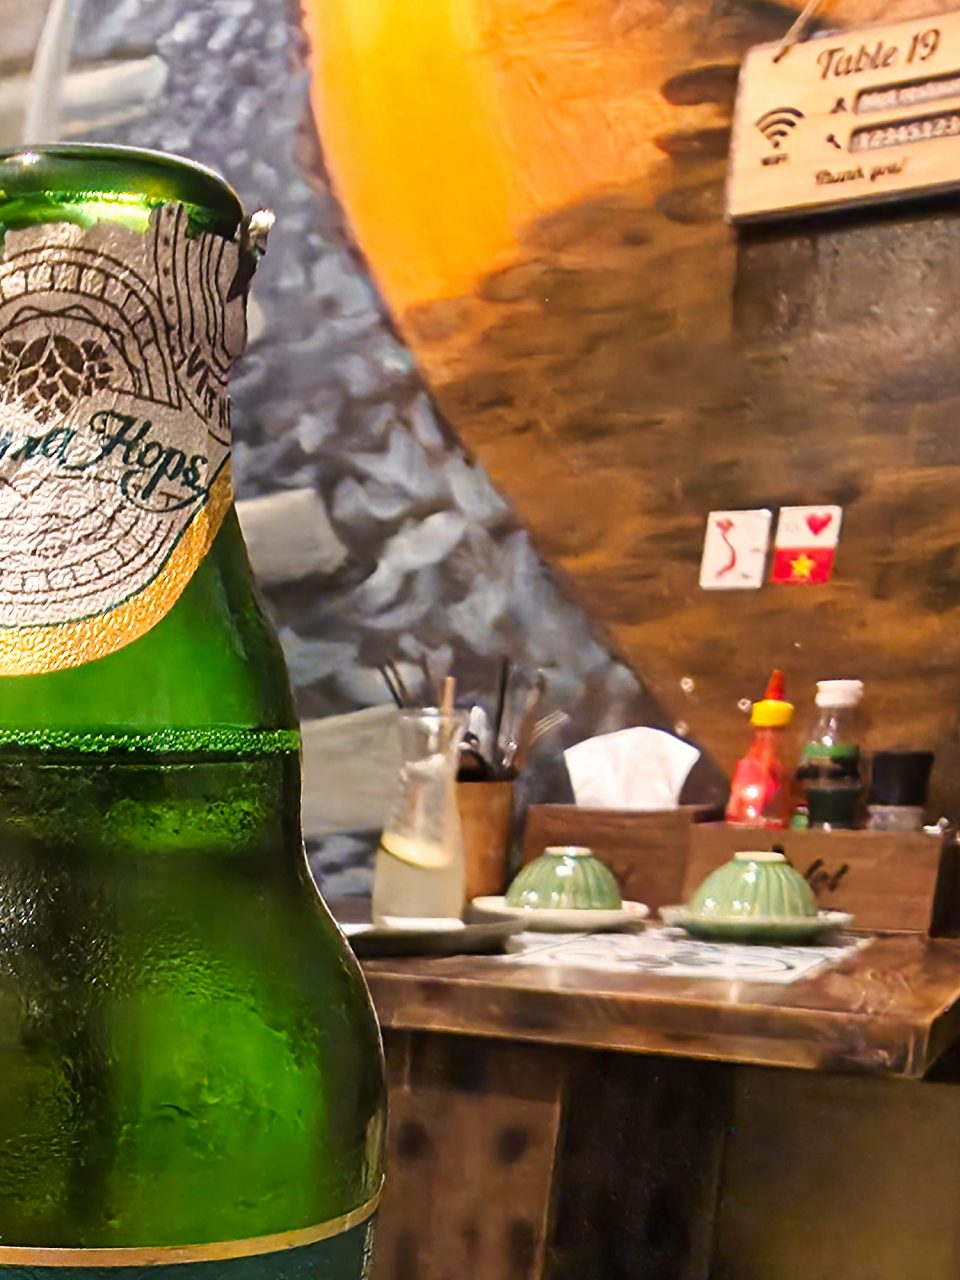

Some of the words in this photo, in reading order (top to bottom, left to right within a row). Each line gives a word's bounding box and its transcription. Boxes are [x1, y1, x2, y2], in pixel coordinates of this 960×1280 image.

[816, 40, 898, 80] Table
[906, 28, 941, 64] 19
[74, 409, 211, 513] Hops
